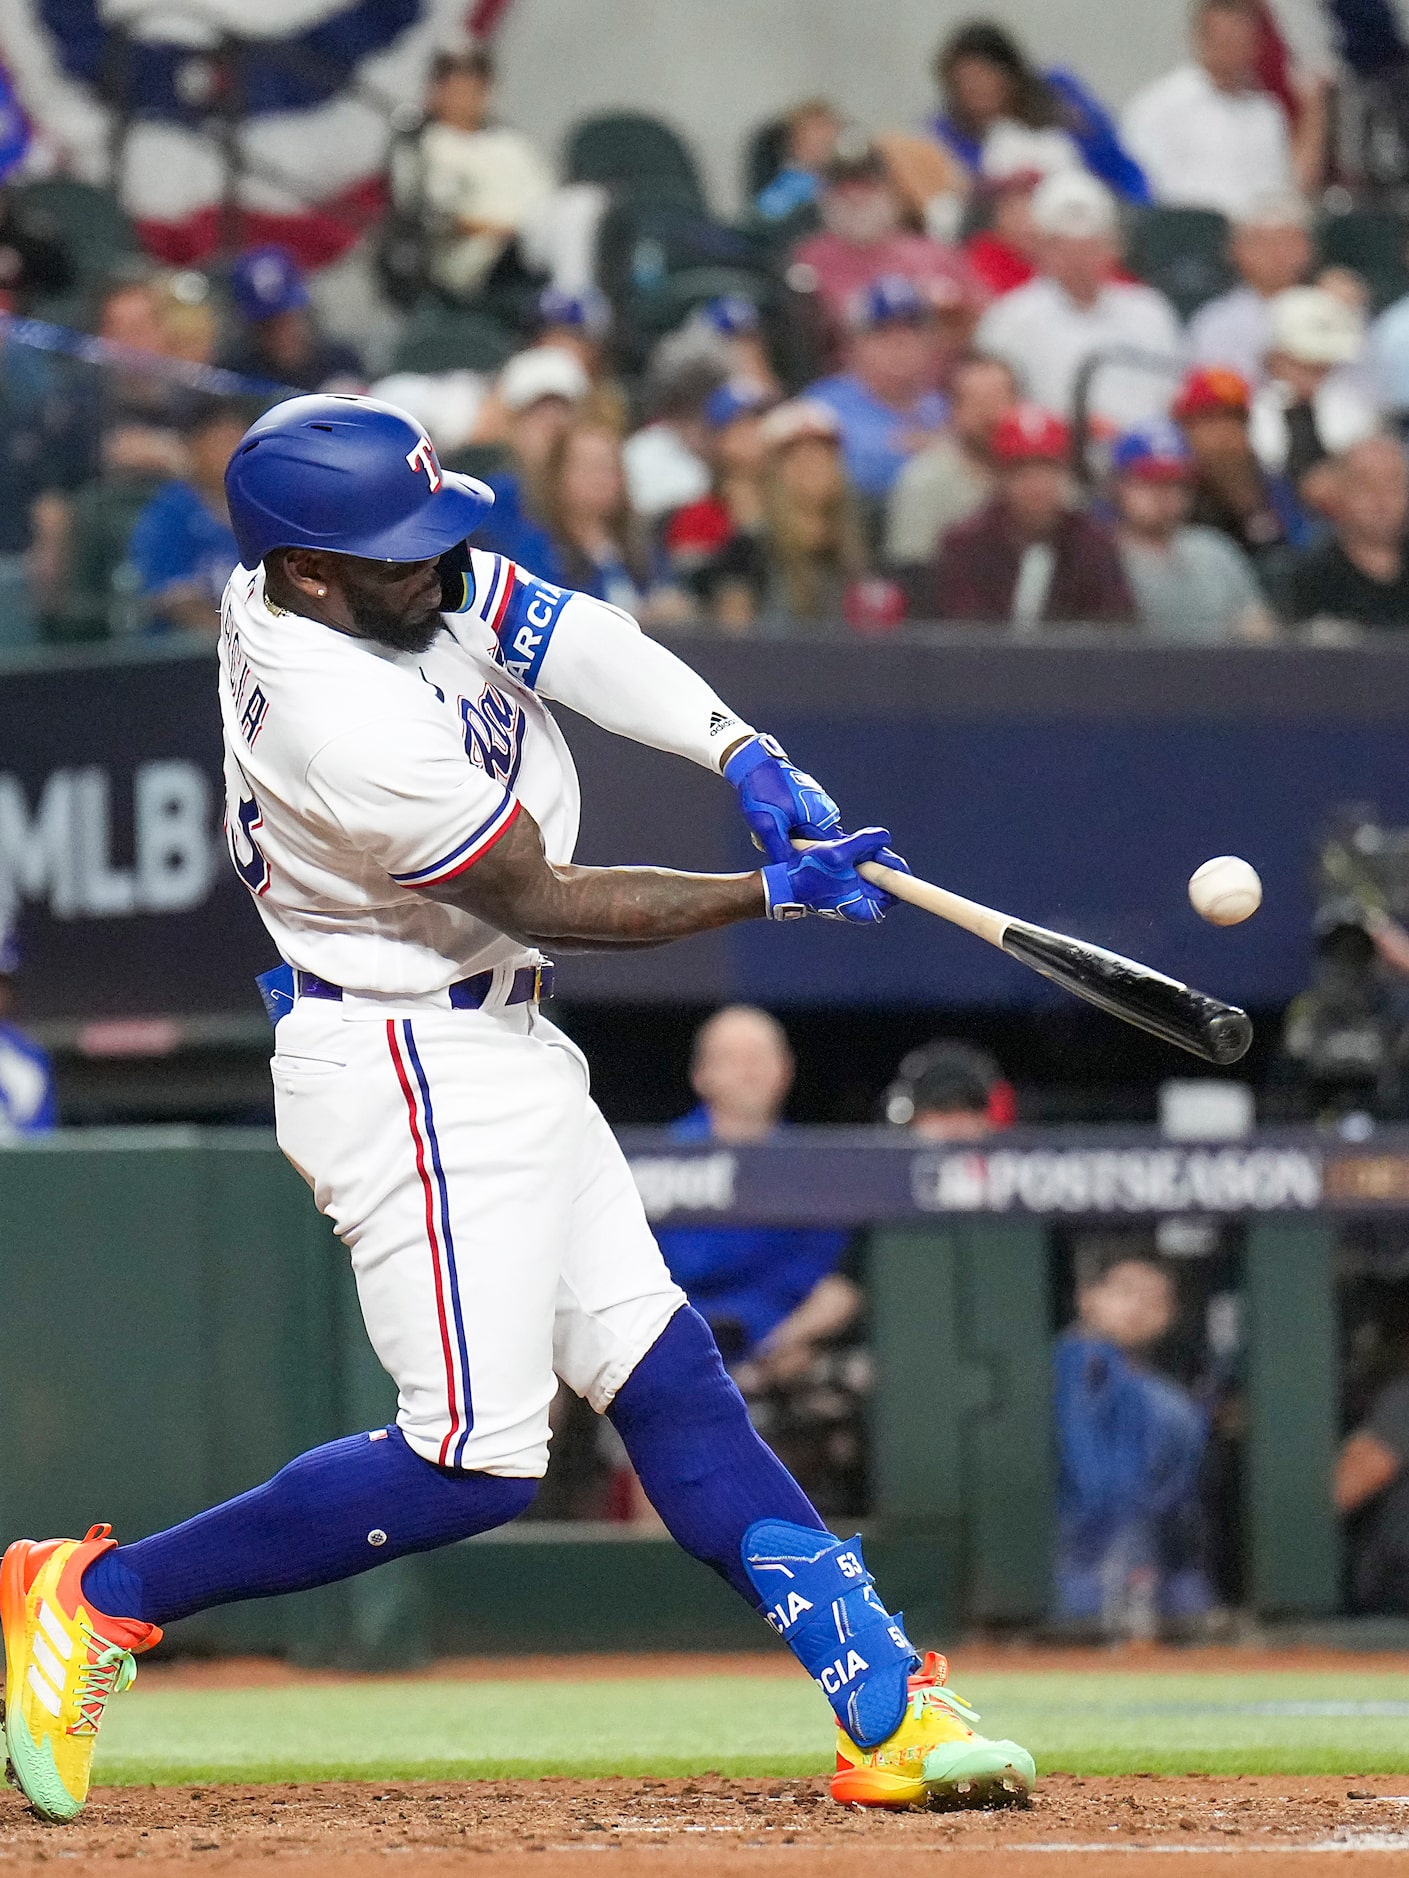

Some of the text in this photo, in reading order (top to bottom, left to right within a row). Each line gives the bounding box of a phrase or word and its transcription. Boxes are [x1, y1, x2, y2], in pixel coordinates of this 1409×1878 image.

[405, 435, 442, 494] T
[988, 1150, 1321, 1213] POSTSEASON
[836, 1551, 863, 1578] 53
[764, 1591, 814, 1635] CIA
[815, 1649, 869, 1694] CIA
